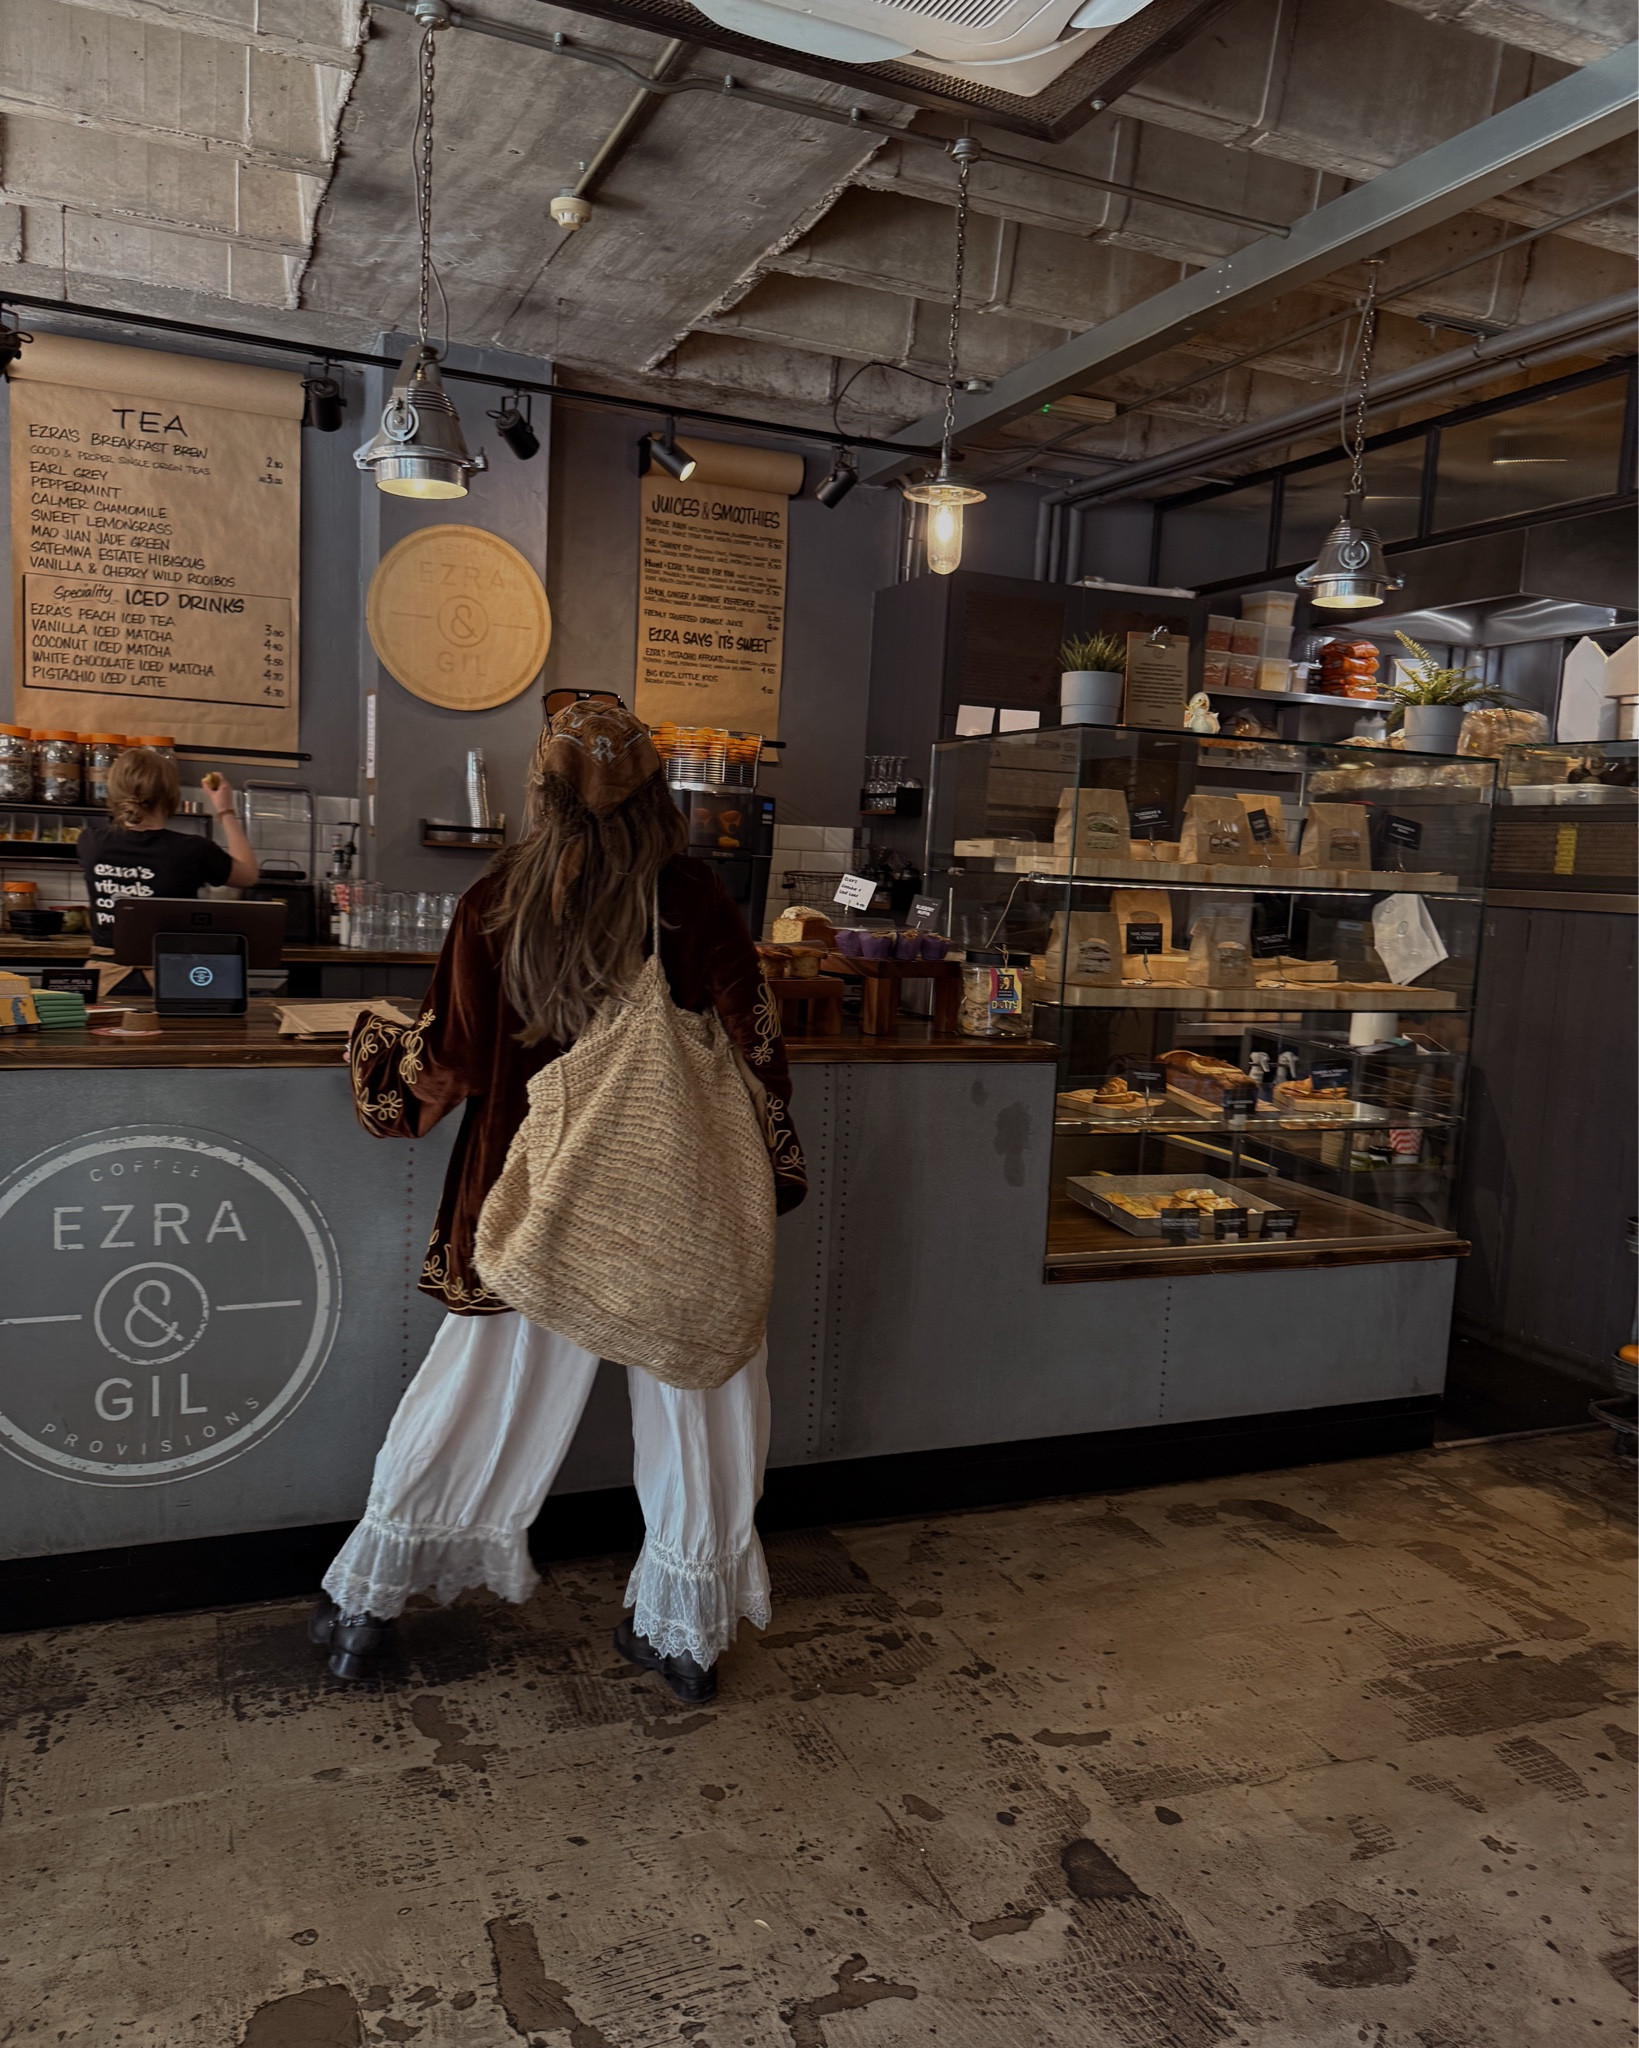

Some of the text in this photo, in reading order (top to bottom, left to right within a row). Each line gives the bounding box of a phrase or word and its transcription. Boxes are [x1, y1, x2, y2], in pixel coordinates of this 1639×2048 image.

[112, 409, 188, 437] TEA
[30, 424, 80, 443] EZRA'S
[91, 433, 169, 453] BREAKFAST
[30, 445, 60, 457] GOOD
[78, 451, 114, 464] PROPER
[118, 456, 150, 468] SINGLE
[152, 461, 183, 472] ORIGIN
[186, 465, 211, 476] TEAS
[30, 461, 108, 482] EARL GREY
[31, 476, 122, 499] PEPPERMINT
[32, 492, 168, 519] CALMER CHAMOMILE
[652, 494, 780, 529] JUICES & SMOOTHIES
[30, 509, 173, 536] SWEET LEMONGRASS
[31, 525, 170, 550] MAO JIAN JADE GREEN
[30, 541, 206, 570] SATEMWA ESTATE HIBISCUS
[30, 556, 236, 588] VANILLA & CHERRY WILD ROOIBOS
[419, 561, 506, 590] EZRA
[52, 584, 245, 614] Speciality ICED DRINKS
[31, 602, 176, 627] EZRA'S PEACH ICED TEA
[450, 604, 478, 640] &
[31, 618, 174, 642] VANILLA ICED MATCHA
[648, 627, 680, 645] EZRA
[682, 631, 712, 648] SAYS
[32, 635, 172, 658] COCONUT ICED MATCHA
[32, 650, 216, 677] WHITE CHOCOLATE ICED MATCHA
[32, 666, 169, 688] PISTACHIO ICED LATTE
[437, 651, 486, 676] GIL
[94, 864, 155, 880] ezra's
[94, 880, 154, 896] rituals
[53, 1200, 248, 1250] EZRA
[124, 1280, 184, 1348] &
[94, 1372, 208, 1422] GIL
[40, 1397, 260, 1456] PROVISIONS
